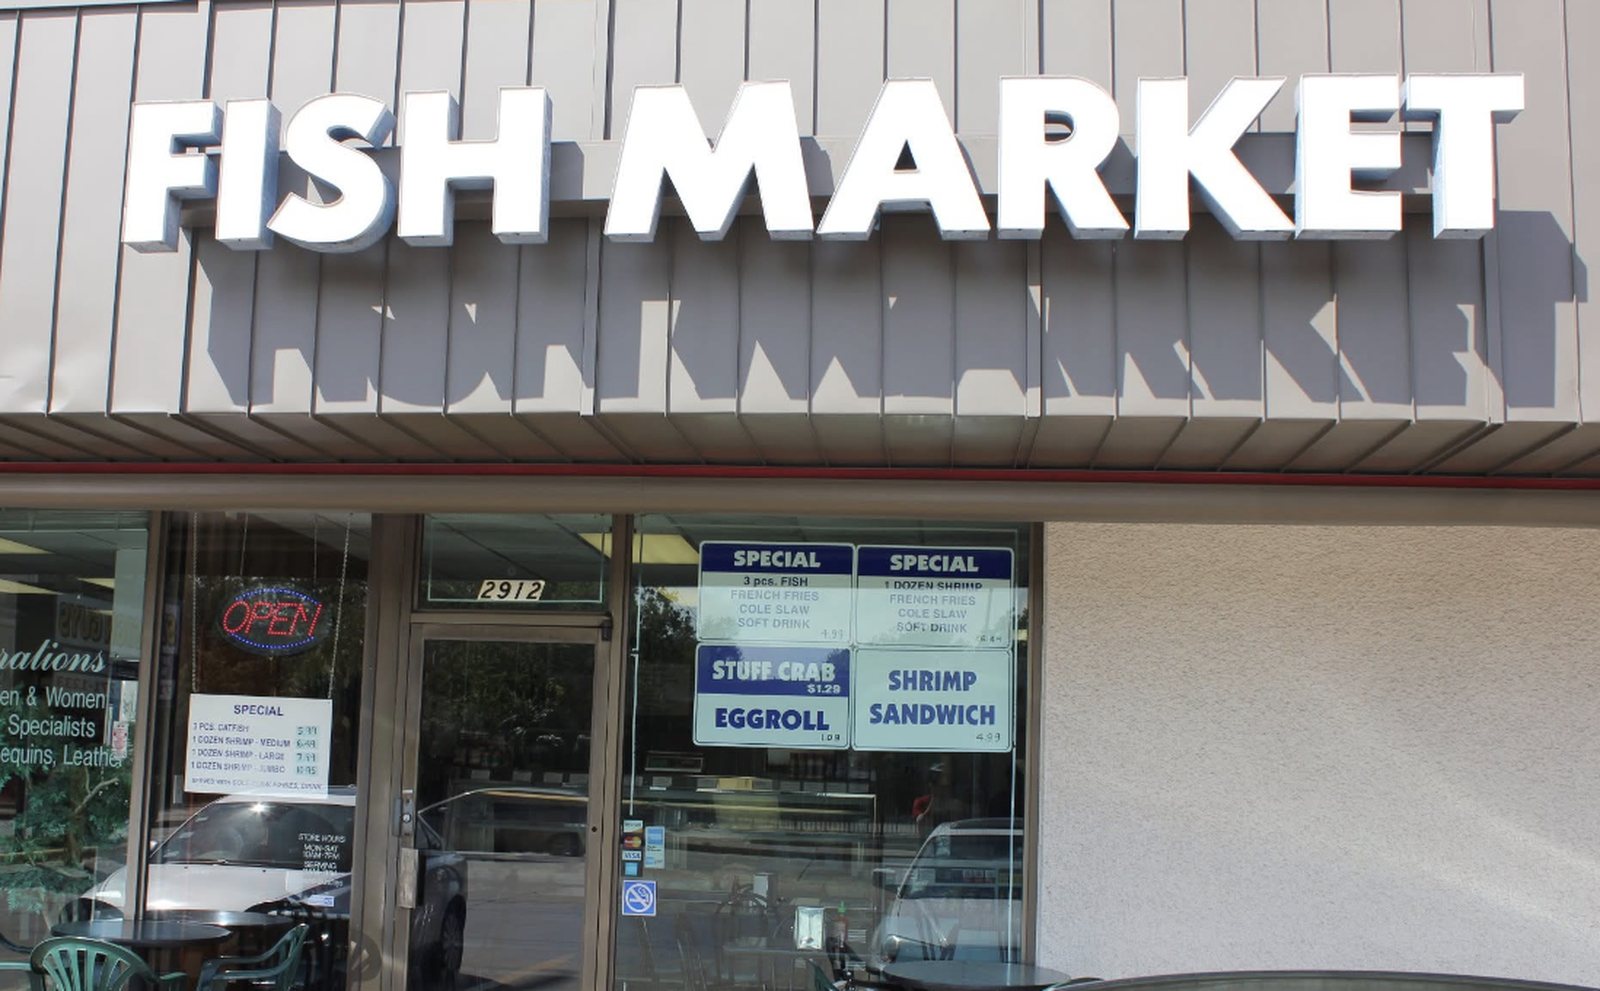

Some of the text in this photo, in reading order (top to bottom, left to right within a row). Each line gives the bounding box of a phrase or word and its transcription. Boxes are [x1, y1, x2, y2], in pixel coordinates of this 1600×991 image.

[122, 73, 1525, 253] FISH MARKET
[734, 550, 821, 568] SPECIAL
[890, 554, 979, 573] SPECIAL
[744, 576, 809, 588] 3 pcs. FISH
[894, 581, 934, 590] DOZEN
[937, 581, 983, 591] SHRIMP
[481, 581, 541, 599] 2912
[731, 589, 820, 601] FRENCH FRIES
[890, 594, 976, 606] FRENCH FRIES
[740, 604, 810, 615] COLE SLAW
[899, 608, 967, 619] COLE SLAW
[222, 600, 324, 636] OPEN
[738, 618, 810, 629] SOFT DRINK
[897, 622, 967, 633] SOFT DRINK
[712, 660, 835, 682] STUFF CRAB
[888, 669, 977, 692] SHRIMP
[26, 686, 37, 706] &
[46, 687, 106, 710] Women
[234, 704, 284, 717] SPECIAL
[869, 703, 996, 726] SANDWICH
[8, 714, 96, 738] Specialists
[715, 708, 830, 731] EGGROLL
[198, 735, 224, 744] DOZEN
[260, 738, 291, 747] MEDIUM
[197, 748, 222, 757] DOZEN
[196, 761, 222, 770] DOZEN
